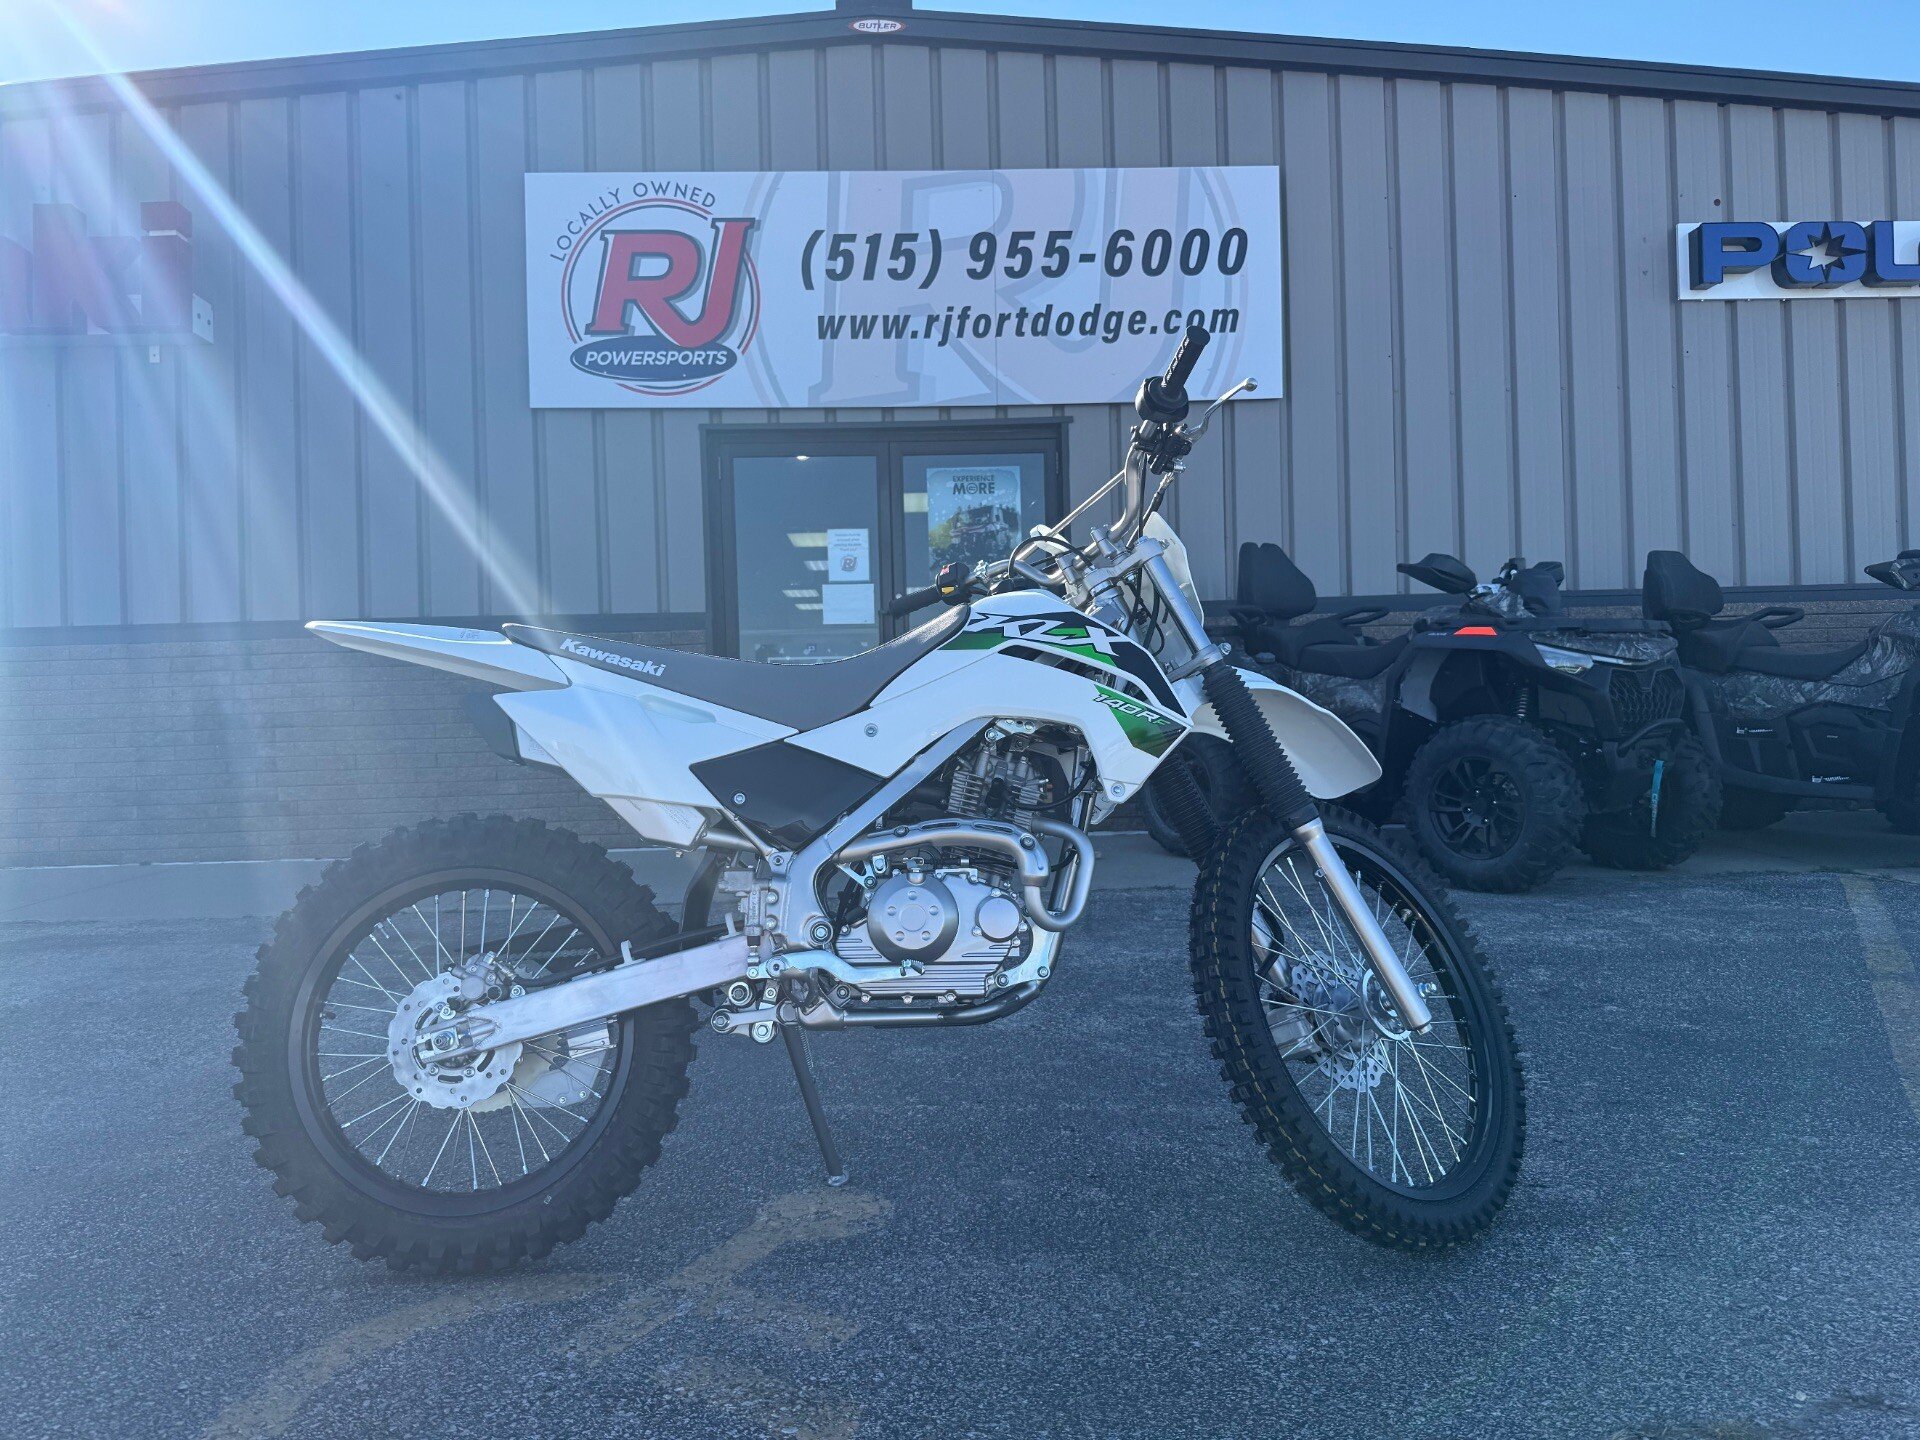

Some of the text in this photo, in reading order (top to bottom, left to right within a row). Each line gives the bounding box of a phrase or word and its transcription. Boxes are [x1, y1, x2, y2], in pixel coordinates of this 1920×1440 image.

[858, 22, 897, 30] BUTLER
[550, 180, 716, 262] LOCALLY OWNED
[801, 227, 1249, 290] (515) 955-6000
[585, 217, 760, 348] RJ
[816, 303, 1240, 348] www.rjfortdodge.com
[585, 350, 728, 367] POWERSPORTS
[952, 474, 995, 483] EXPERIENCE
[952, 482, 995, 495] MORE
[559, 638, 667, 677] Kawasaki
